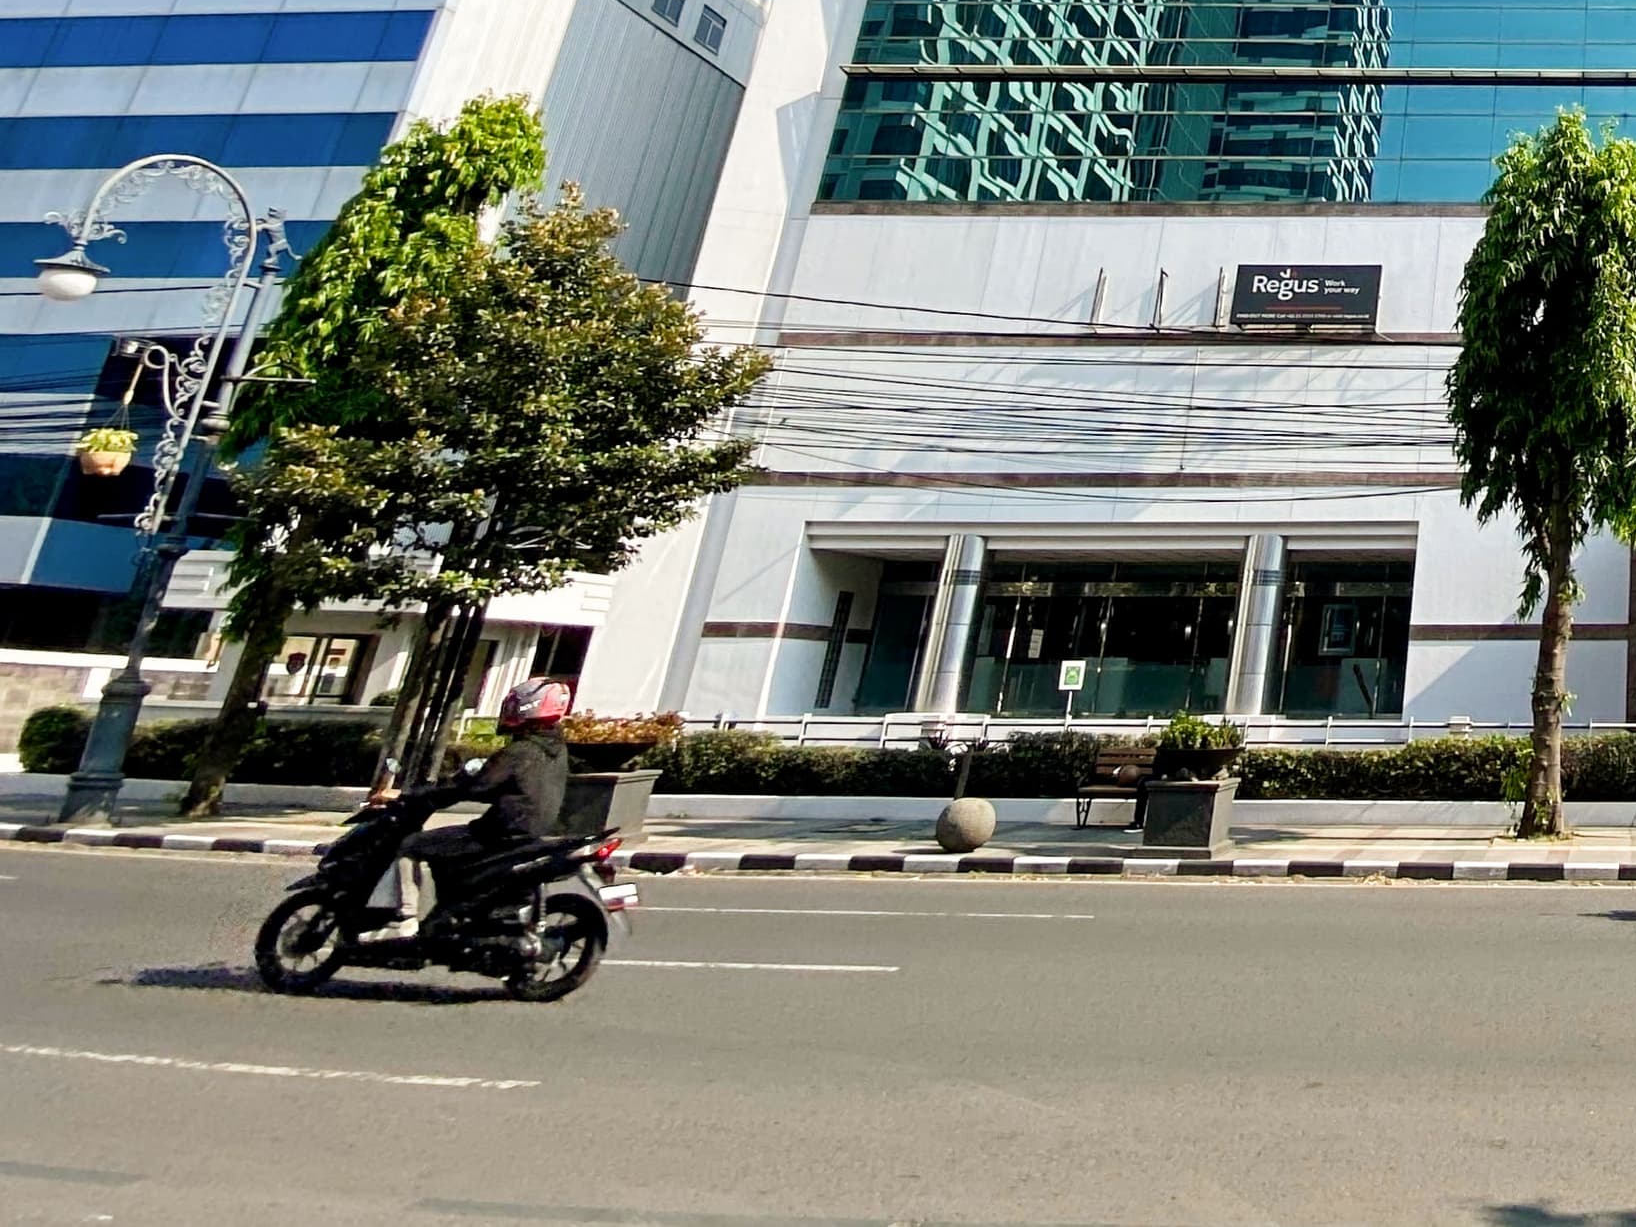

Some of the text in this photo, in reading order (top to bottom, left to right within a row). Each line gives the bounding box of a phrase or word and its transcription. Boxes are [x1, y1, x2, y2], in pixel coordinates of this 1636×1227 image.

[1325, 279, 1346, 287] Work
[1252, 275, 1319, 301] Regus
[1323, 287, 1360, 295] your way
